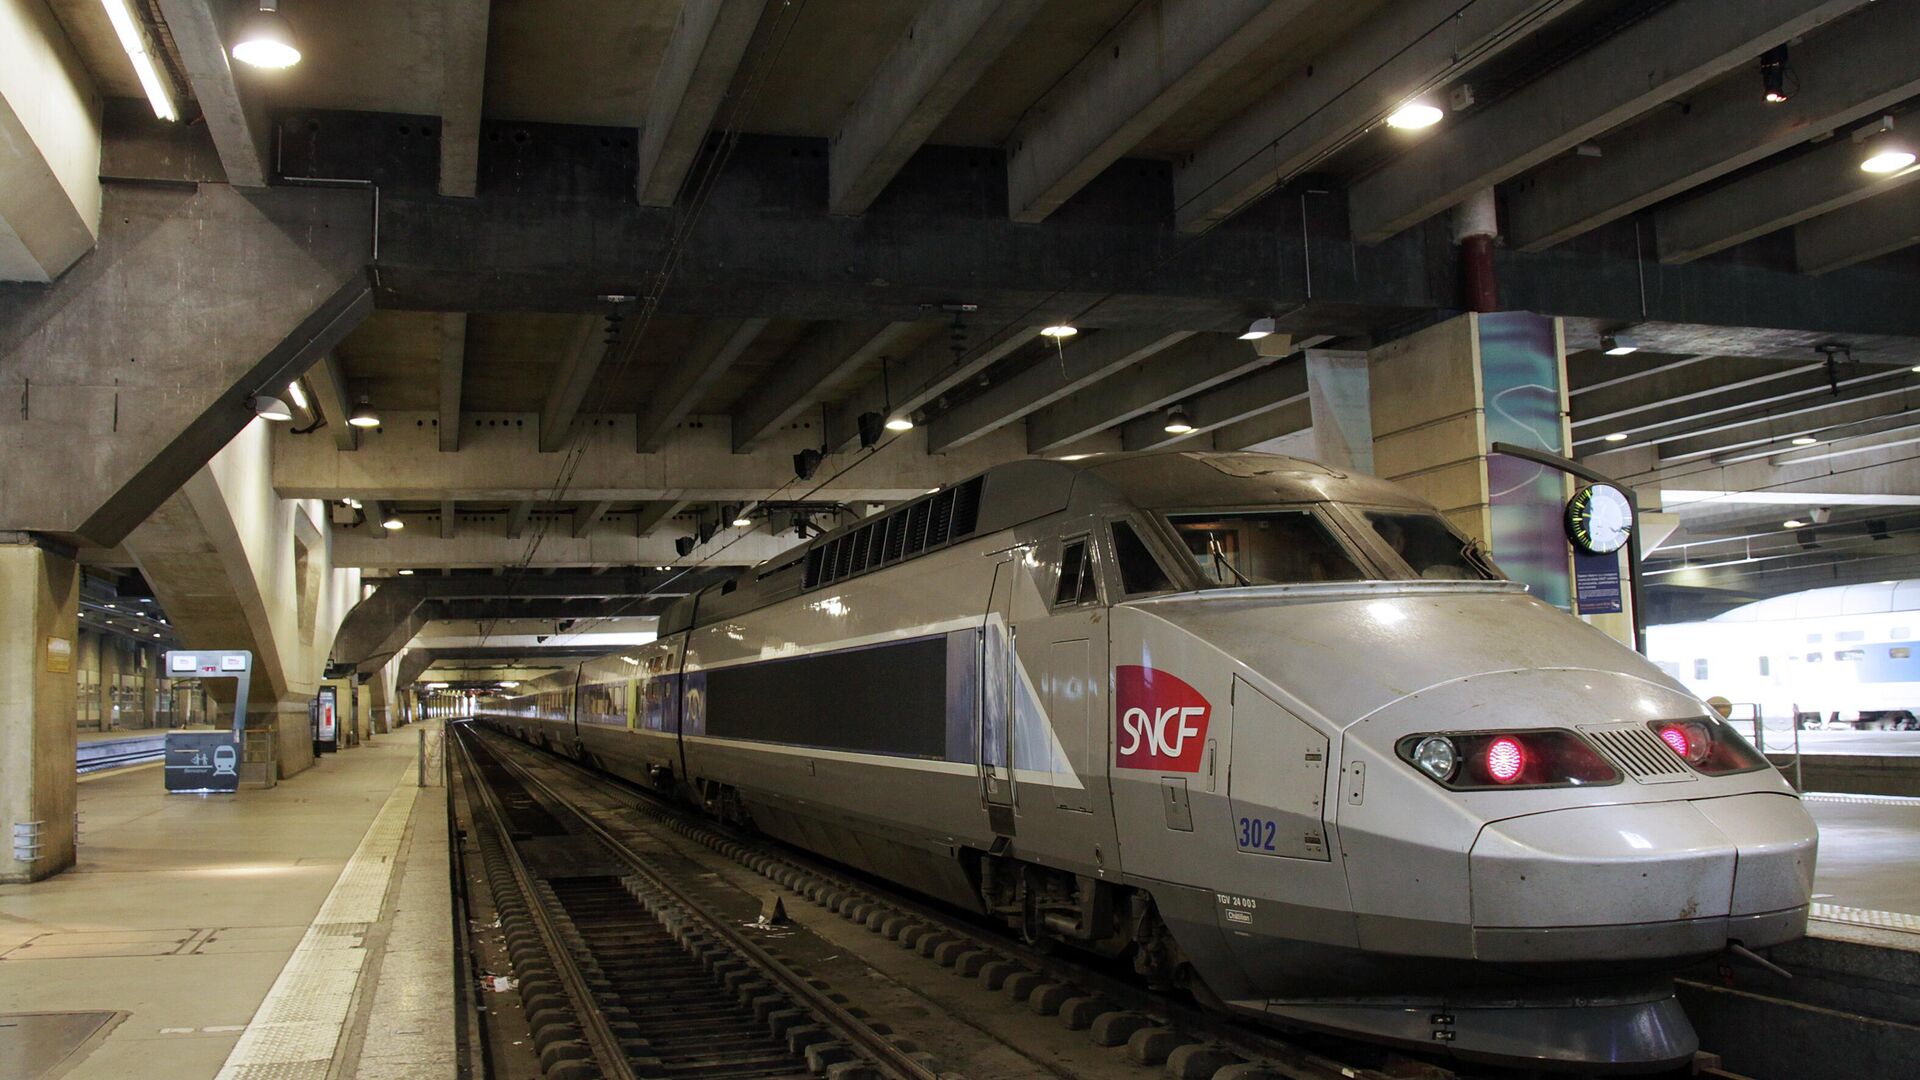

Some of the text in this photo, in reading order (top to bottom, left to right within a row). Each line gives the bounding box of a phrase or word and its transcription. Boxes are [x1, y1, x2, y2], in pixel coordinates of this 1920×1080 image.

[1120, 706, 1205, 758] SNCF
[1239, 817, 1276, 850] 302
[1216, 894, 1231, 905] TGV
